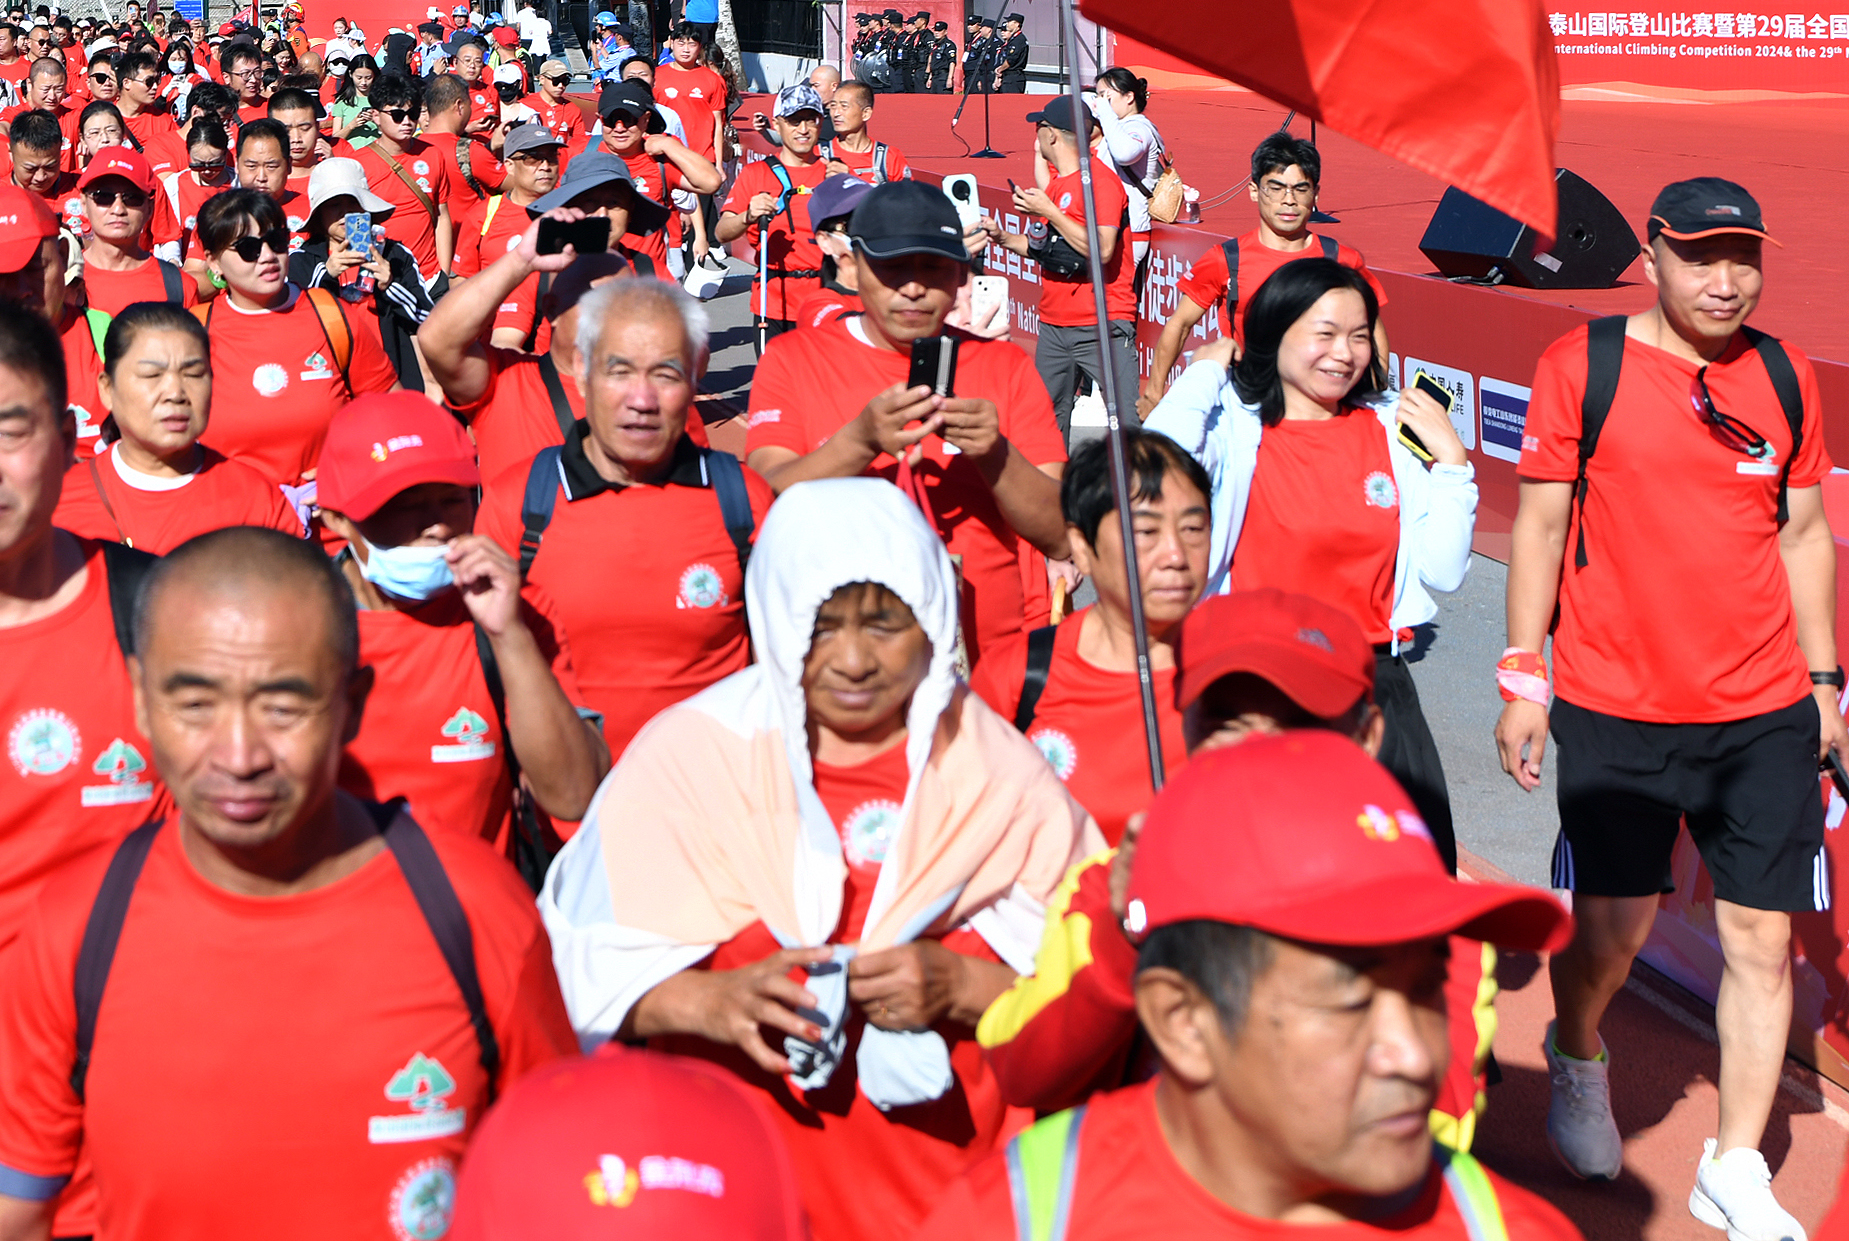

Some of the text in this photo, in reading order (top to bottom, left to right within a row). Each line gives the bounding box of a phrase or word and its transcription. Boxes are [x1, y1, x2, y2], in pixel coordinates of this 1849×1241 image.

[1553, 43, 1622, 56] nternational
[1625, 44, 1676, 58] Climbing
[1679, 45, 1752, 59] Competition
[1795, 46, 1816, 58] the
[1819, 46, 1842, 58] 29th
